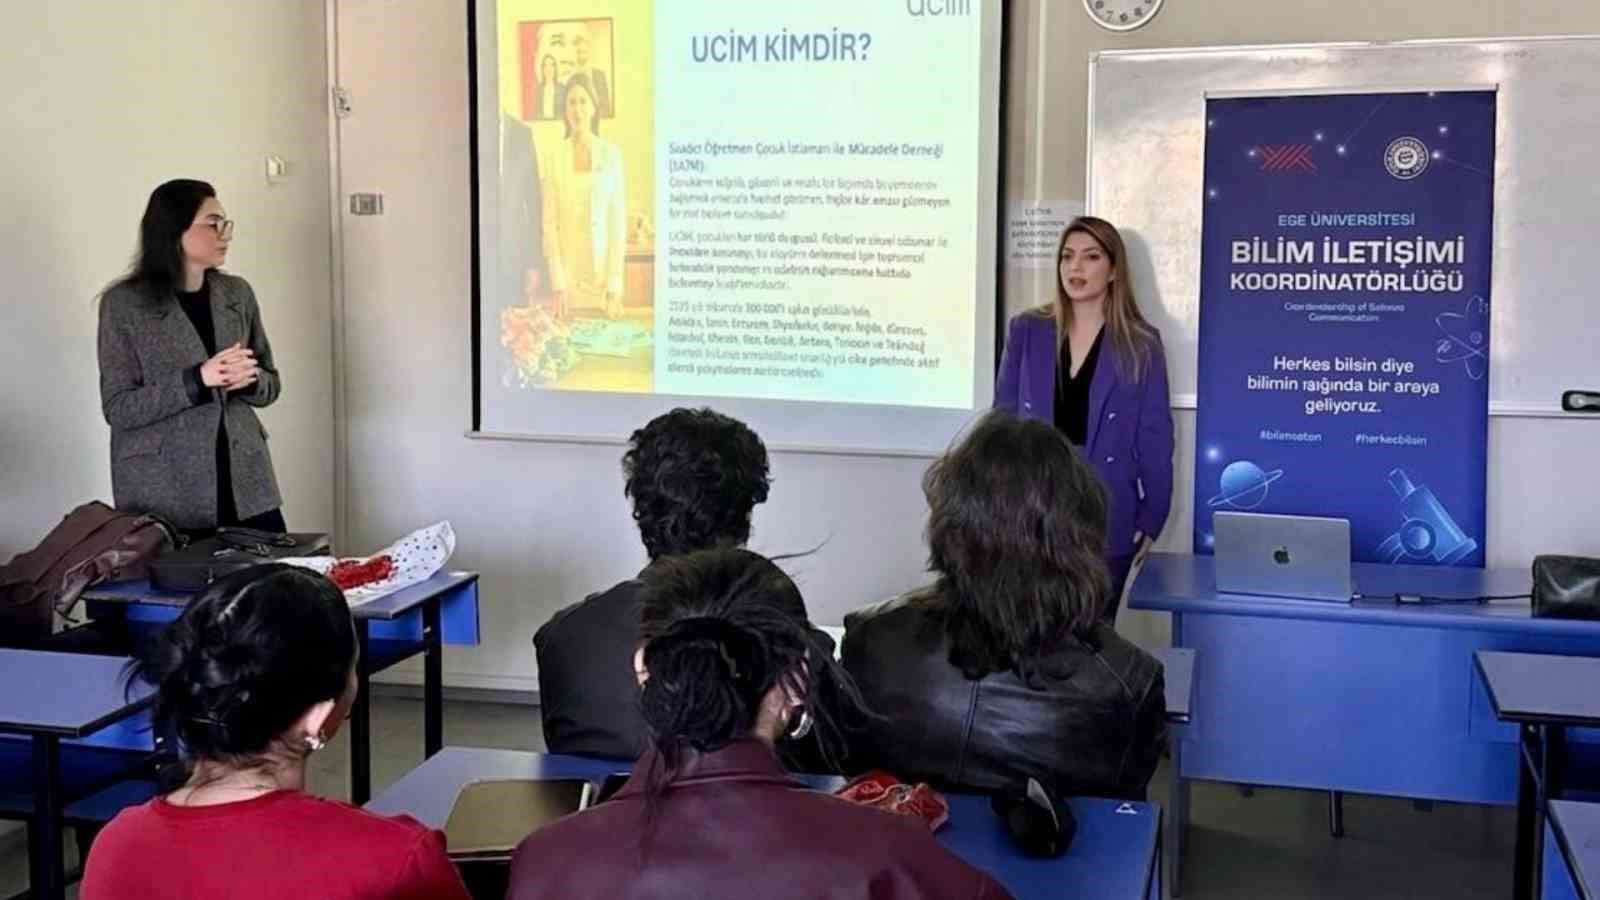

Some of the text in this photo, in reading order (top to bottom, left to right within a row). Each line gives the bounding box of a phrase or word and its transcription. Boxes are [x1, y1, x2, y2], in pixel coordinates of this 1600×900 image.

[691, 26, 872, 63] UCİM KİMDİR?
[1278, 211, 1415, 226] EGE ÜNİVERSİTESİ
[1232, 236, 1464, 268] BİLİM İLETİŞİMİ
[1230, 270, 1463, 292] KOORDİNATÖRLÜĞÜ
[1273, 356, 1414, 376] Herkes bilsin diye
[1247, 375, 1298, 390] bilimin
[1368, 379, 1390, 392] bir
[1393, 382, 1440, 397] araya
[1305, 398, 1381, 415] geliyoruz.
